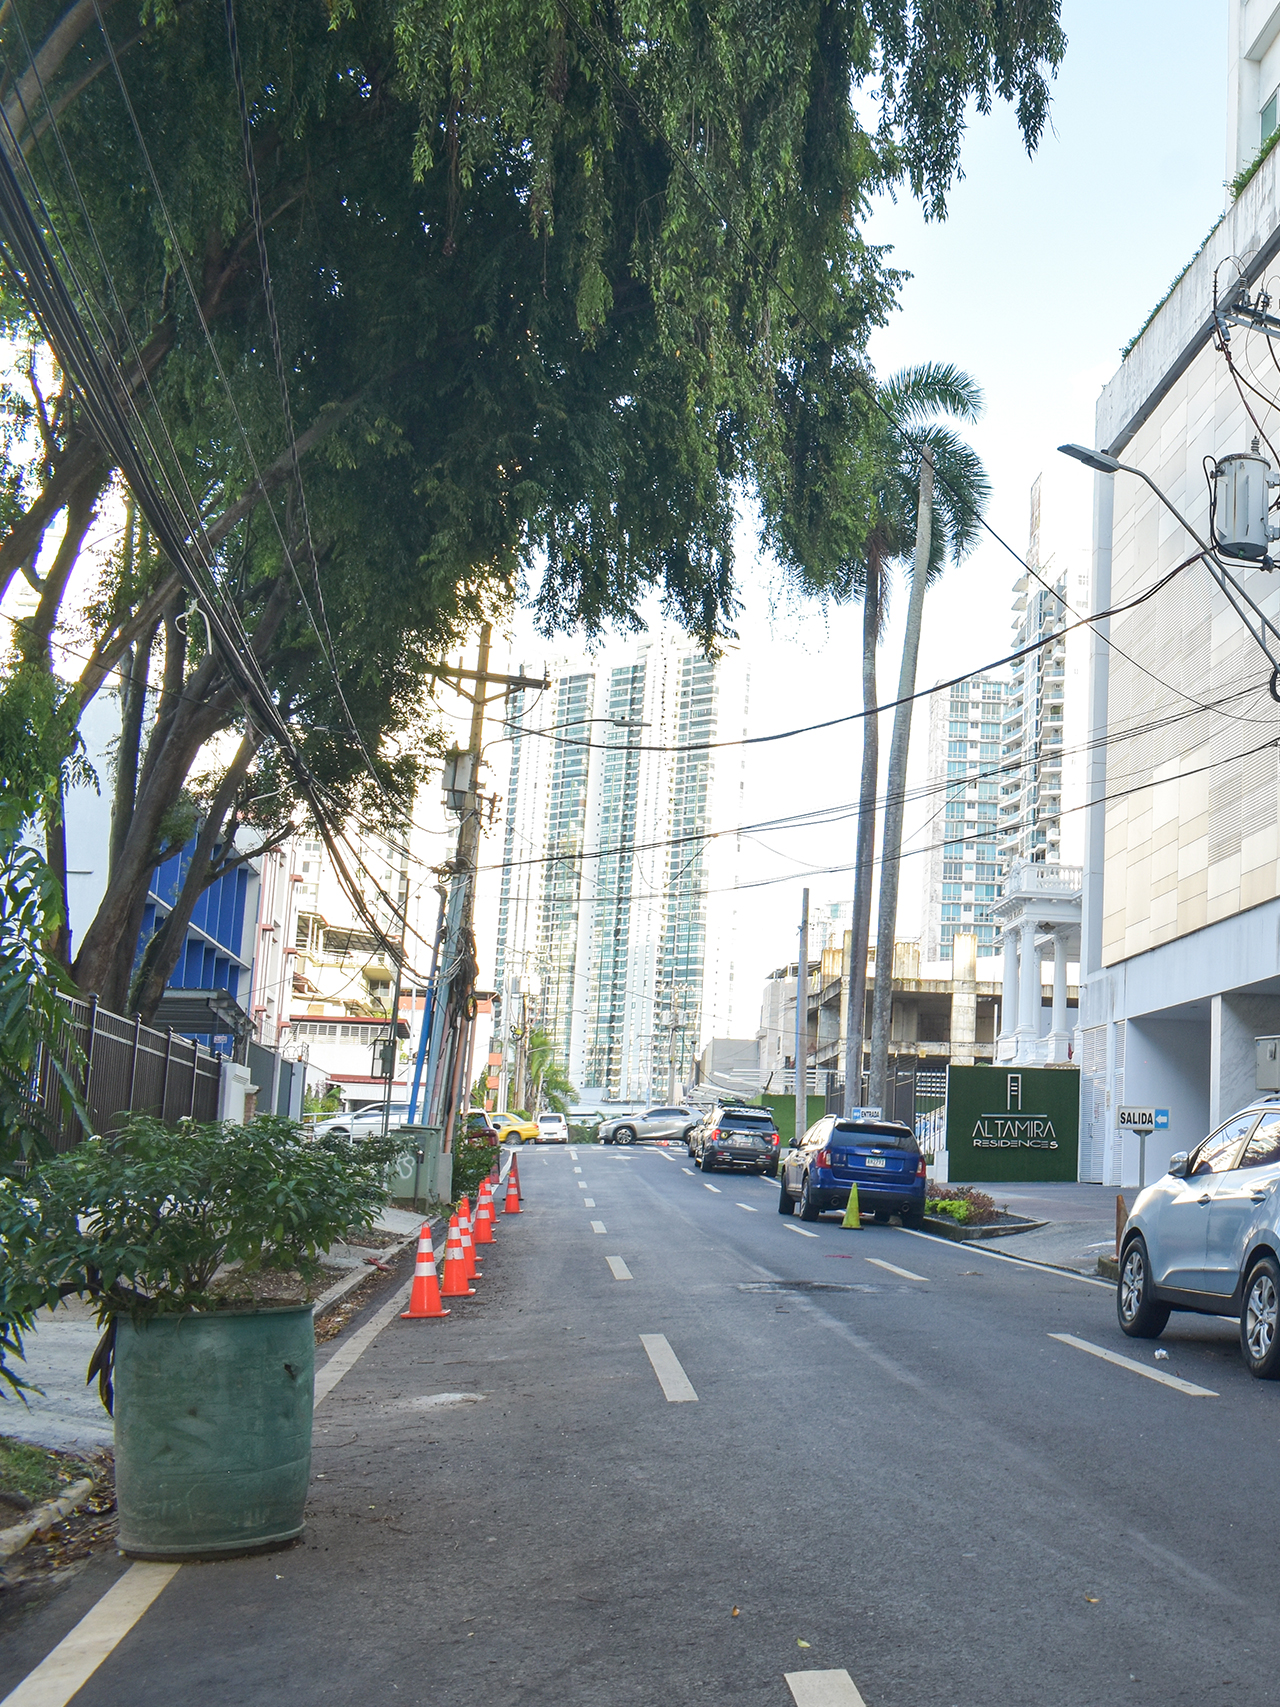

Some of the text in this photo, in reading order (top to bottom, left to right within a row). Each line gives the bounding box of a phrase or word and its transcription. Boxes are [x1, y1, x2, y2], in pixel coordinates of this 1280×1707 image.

[861, 1110, 880, 1118] ENTRADA
[1120, 1112, 1154, 1125] SALIDA
[972, 1120, 1056, 1138] ALTAMIRA
[973, 1139, 1059, 1149] RESIDENCES
